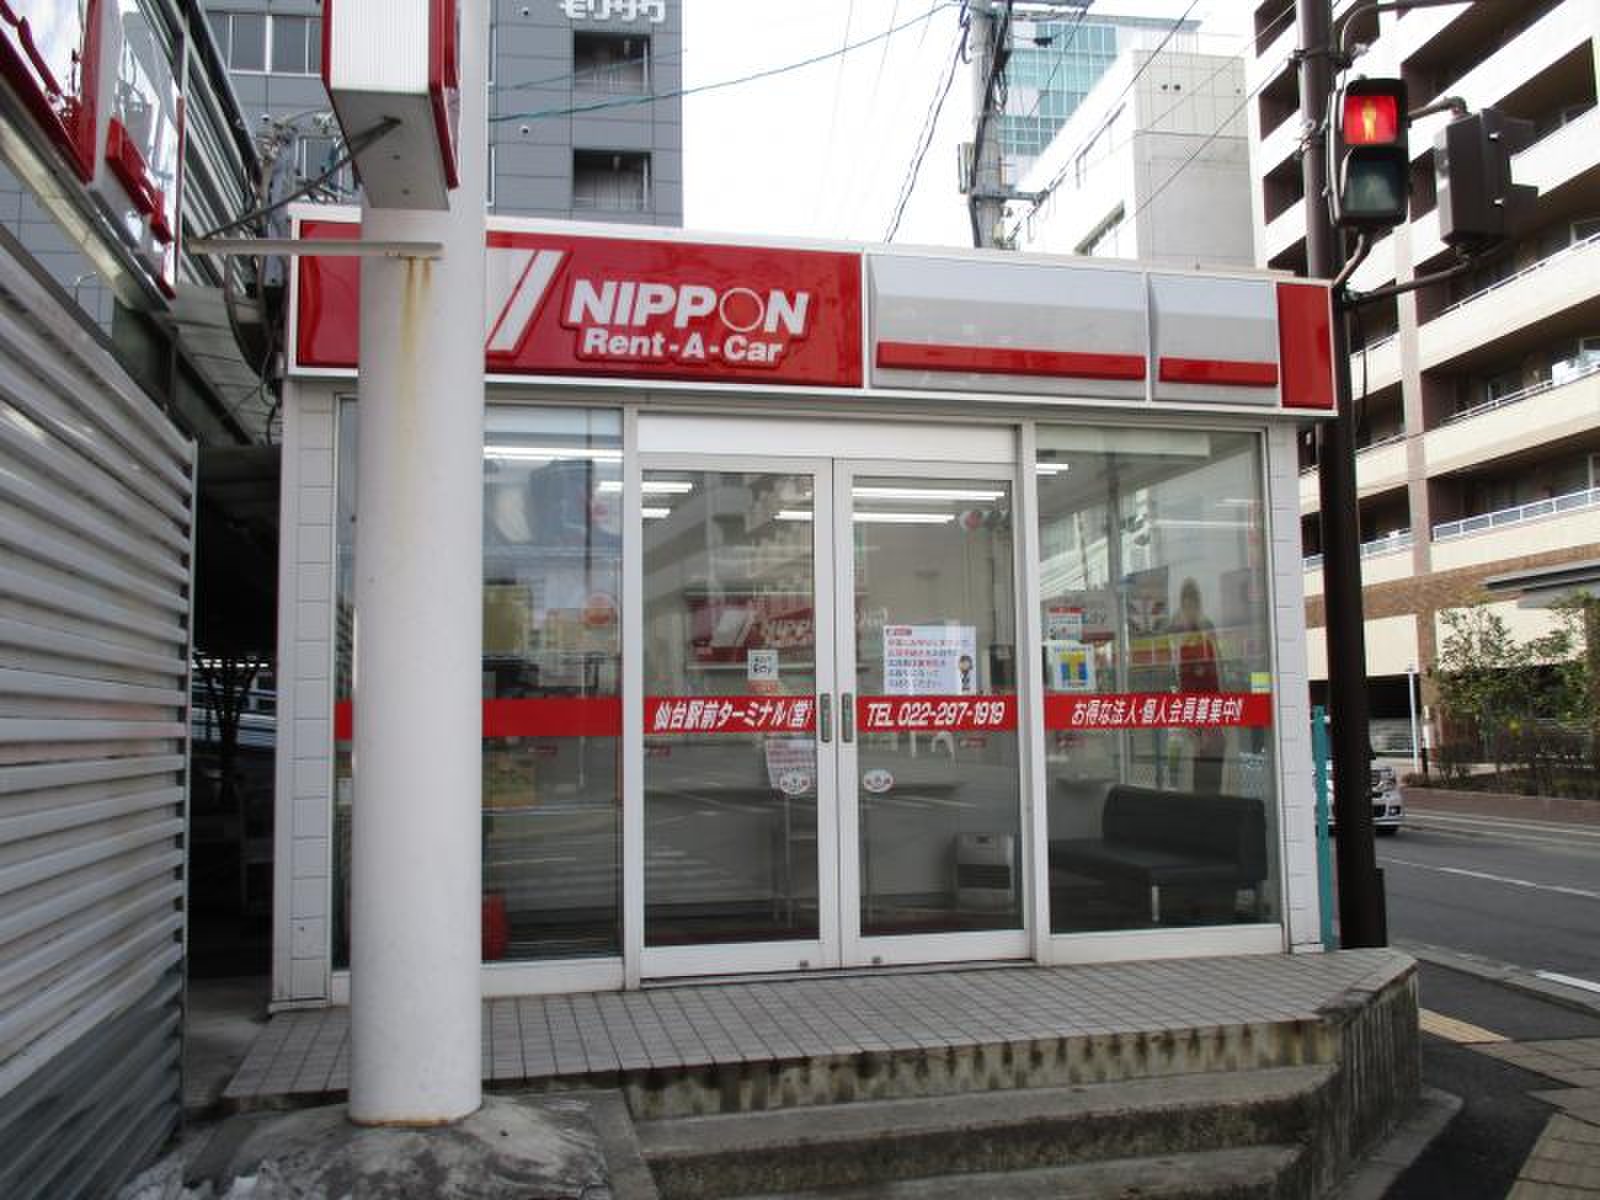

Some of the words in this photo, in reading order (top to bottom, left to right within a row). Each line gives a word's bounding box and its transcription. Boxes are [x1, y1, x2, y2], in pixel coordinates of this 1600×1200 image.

[567, 279, 810, 335] NIPPON
[583, 327, 783, 363] Rent-A-Car
[866, 703, 895, 727] TEL
[898, 701, 1006, 727] 022-297-1919
